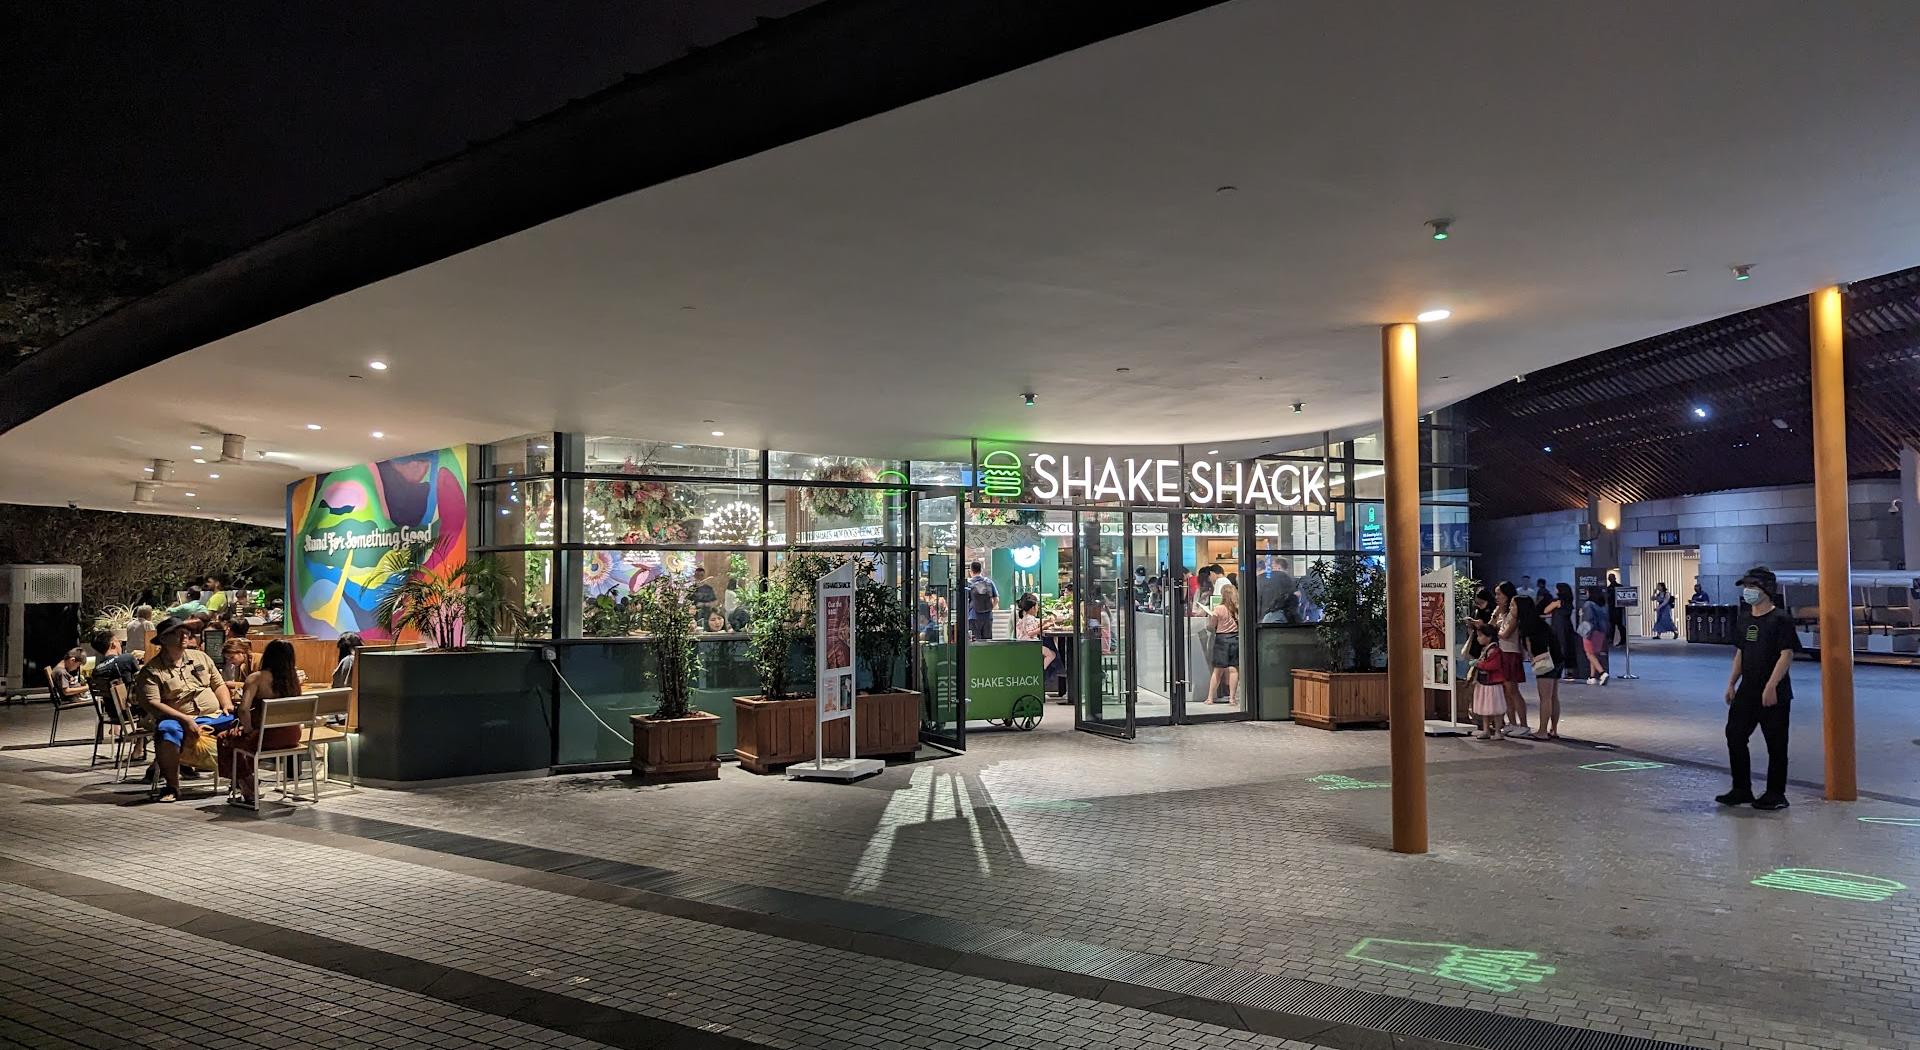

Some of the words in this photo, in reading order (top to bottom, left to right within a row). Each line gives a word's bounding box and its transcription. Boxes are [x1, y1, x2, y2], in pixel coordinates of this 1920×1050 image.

[1032, 454, 1180, 502] SHAKE
[1190, 461, 1328, 507] SHACK
[345, 528, 400, 550] Something
[400, 522, 432, 550] Good
[971, 677, 1004, 688] SHAKE
[1006, 676, 1039, 686] SHACK
